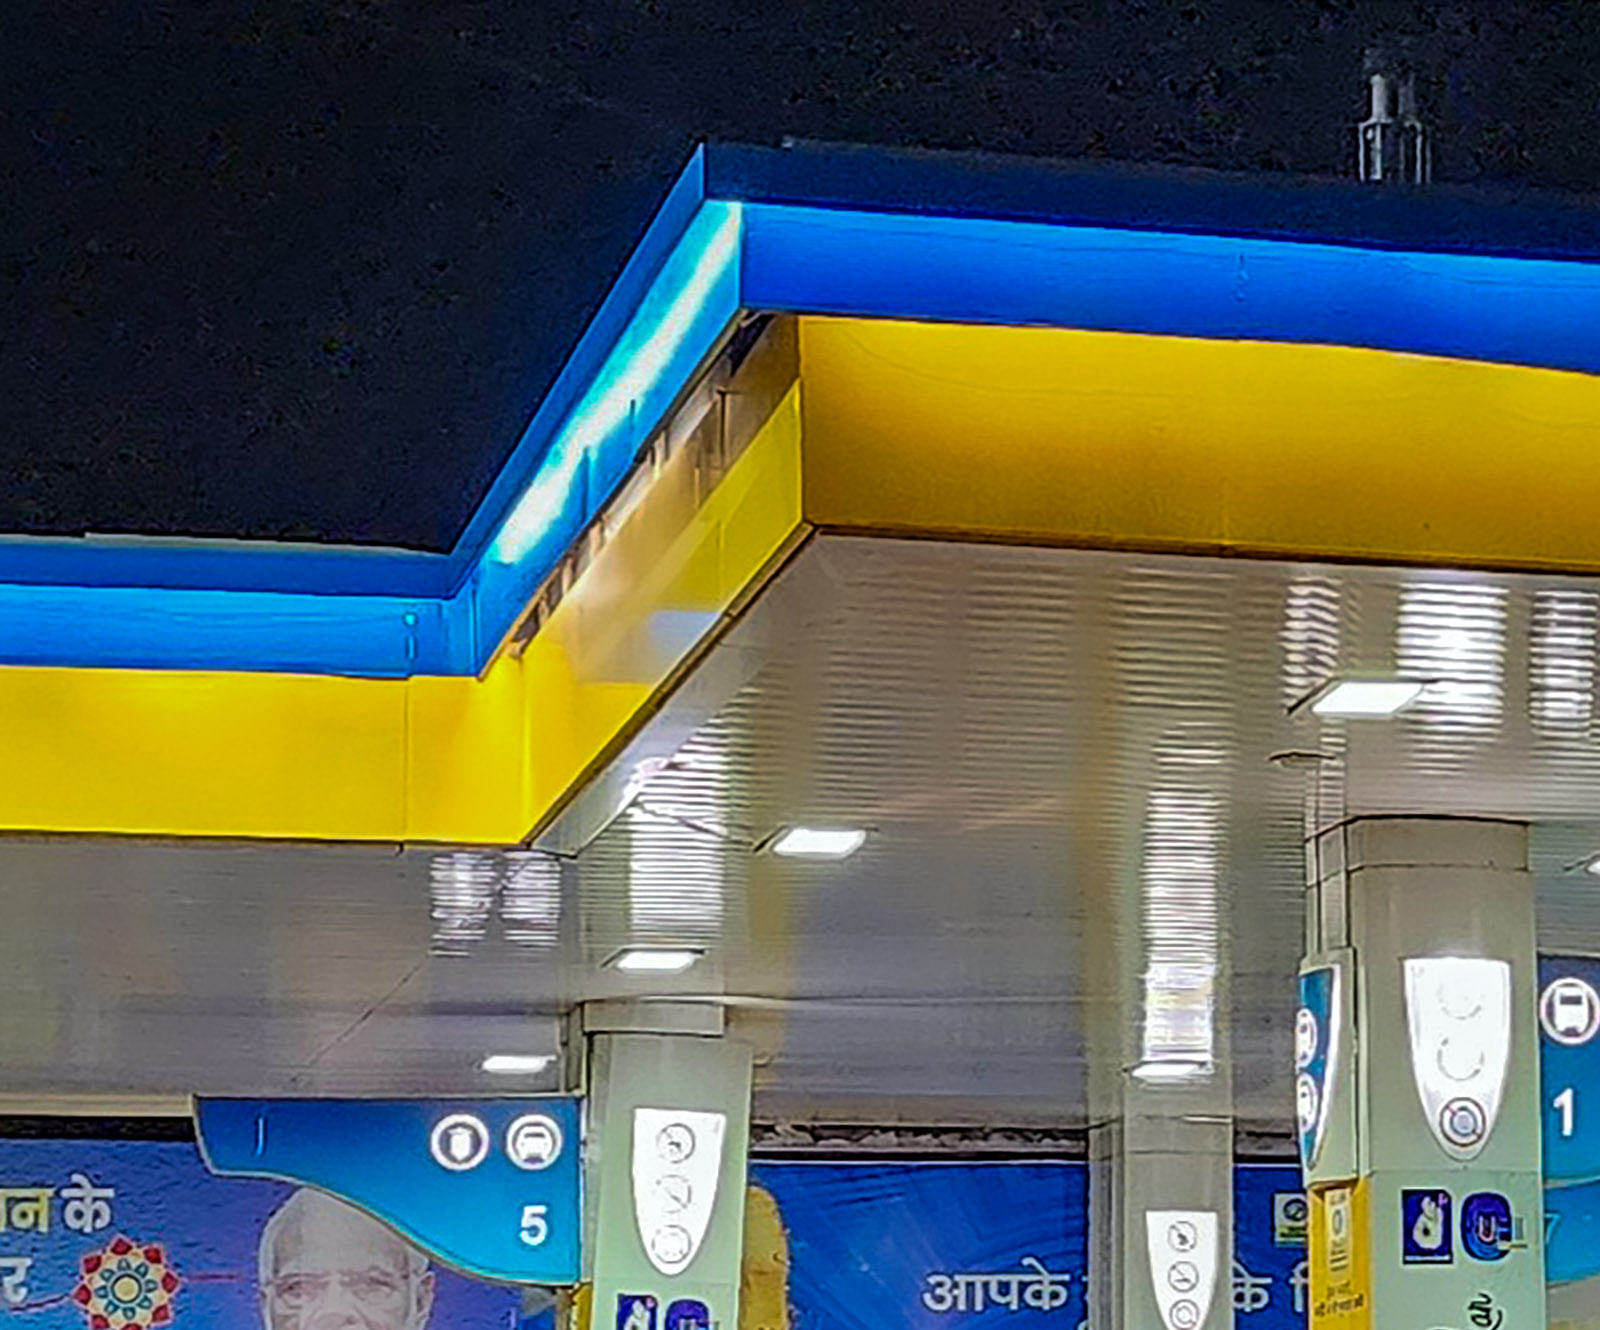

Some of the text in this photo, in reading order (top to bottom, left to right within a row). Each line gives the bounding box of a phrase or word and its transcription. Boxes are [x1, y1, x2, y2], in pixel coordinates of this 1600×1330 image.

[1553, 1087, 1574, 1137] 1
[61, 1173, 115, 1231] के
[521, 1205, 548, 1247] 5
[923, 1257, 1069, 1312] आपके
